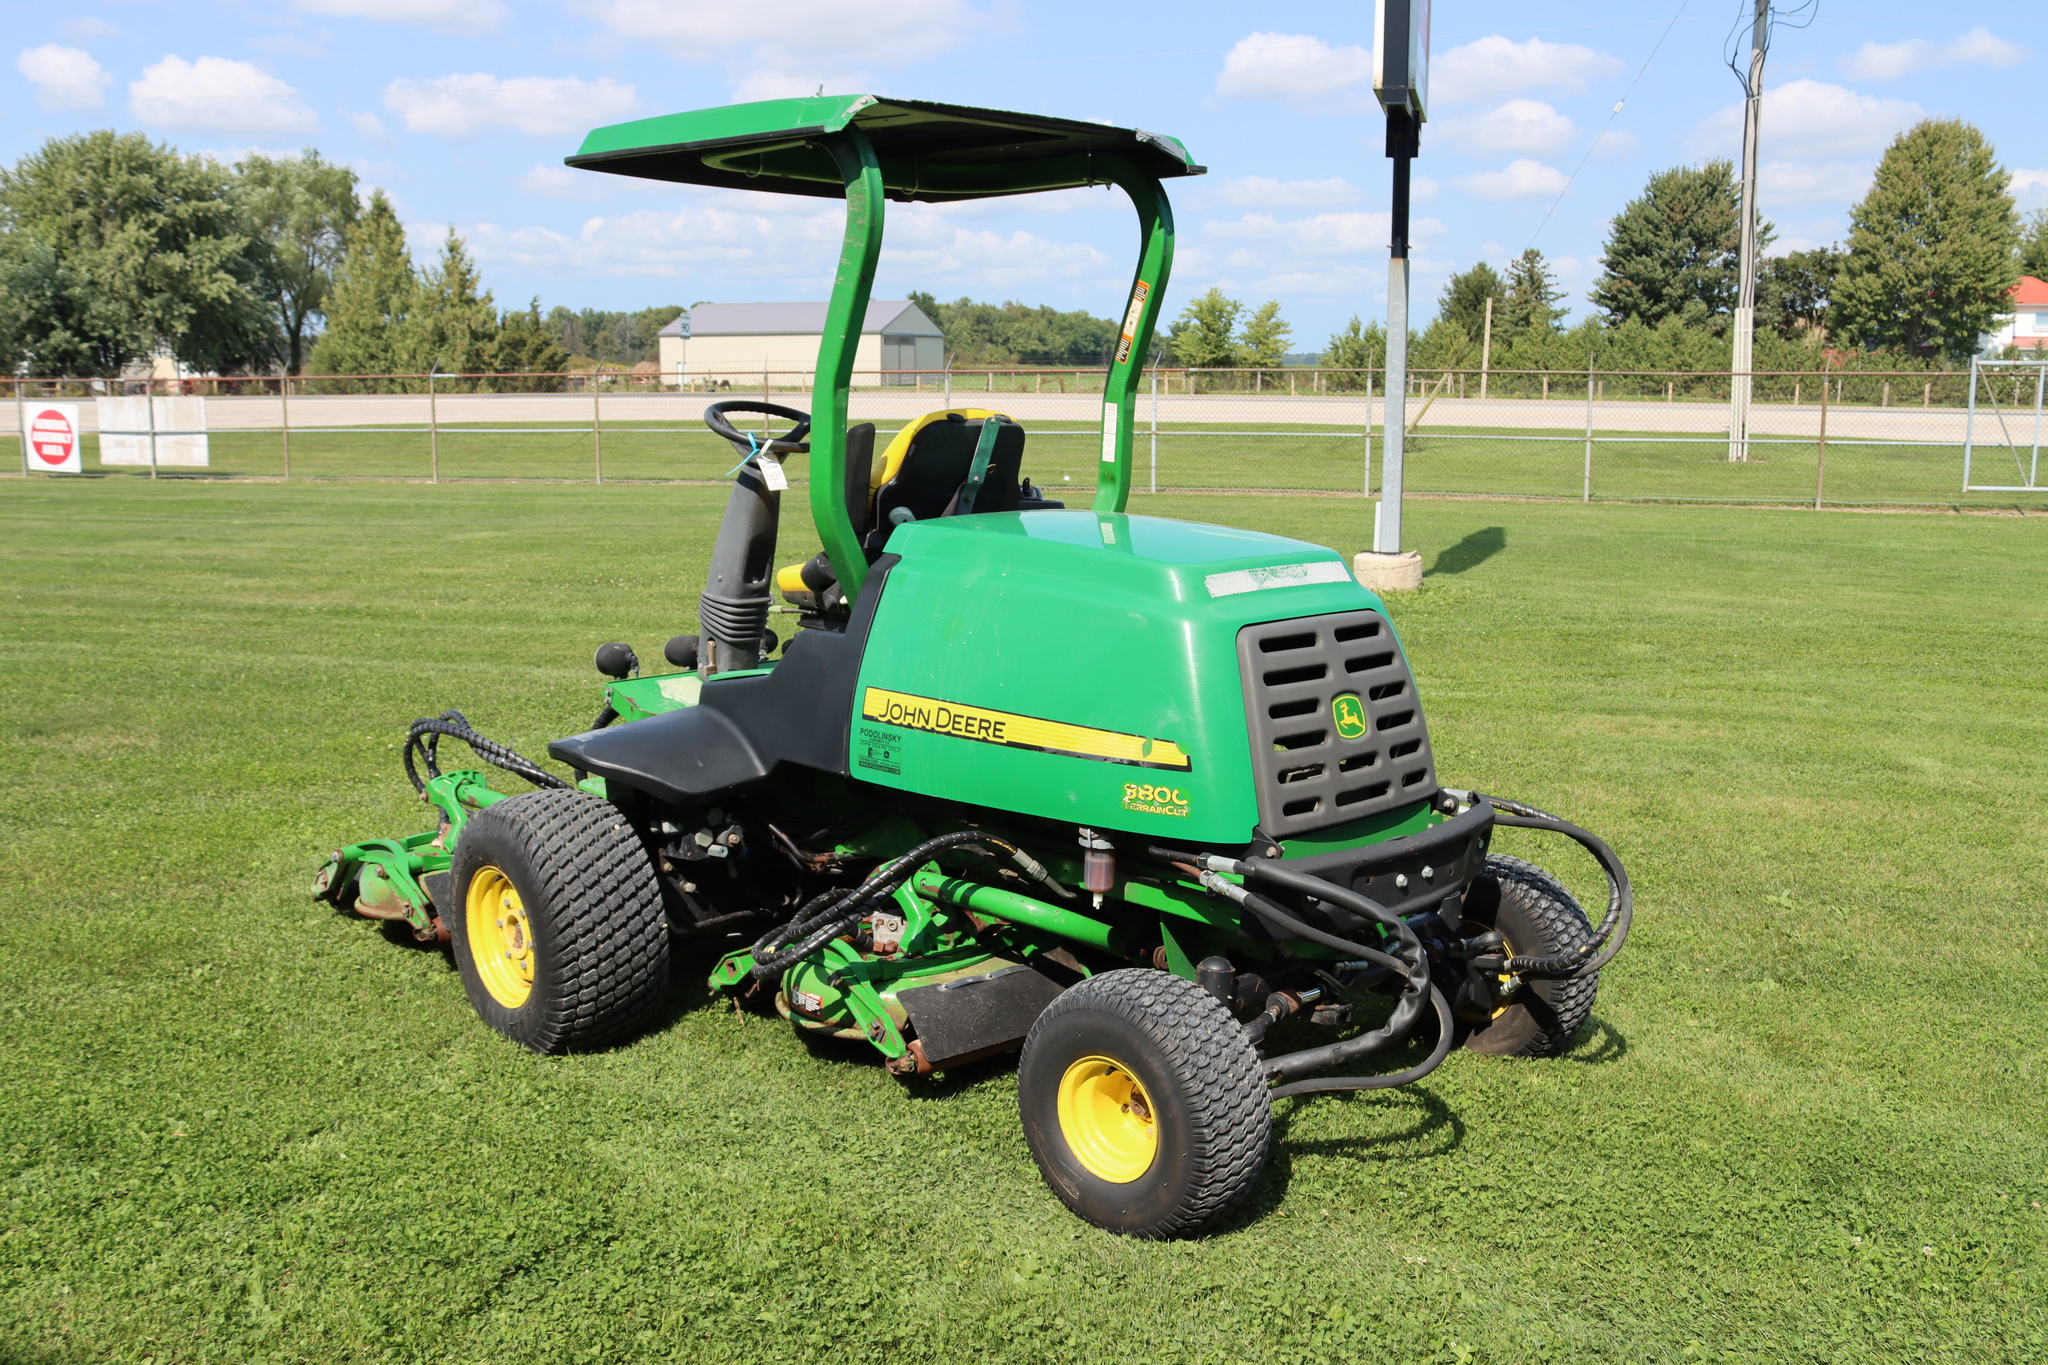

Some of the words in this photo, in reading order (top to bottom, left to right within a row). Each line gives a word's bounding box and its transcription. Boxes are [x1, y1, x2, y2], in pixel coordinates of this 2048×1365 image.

[681, 322, 690, 332] 90
[33, 418, 69, 431] GENERAL
[32, 431, 72, 444] ASSEMBLY
[41, 444, 65, 456] AREA
[878, 698, 931, 727] JOHN
[936, 706, 1006, 740] DEERE
[860, 728, 902, 743] PODOLINSKY
